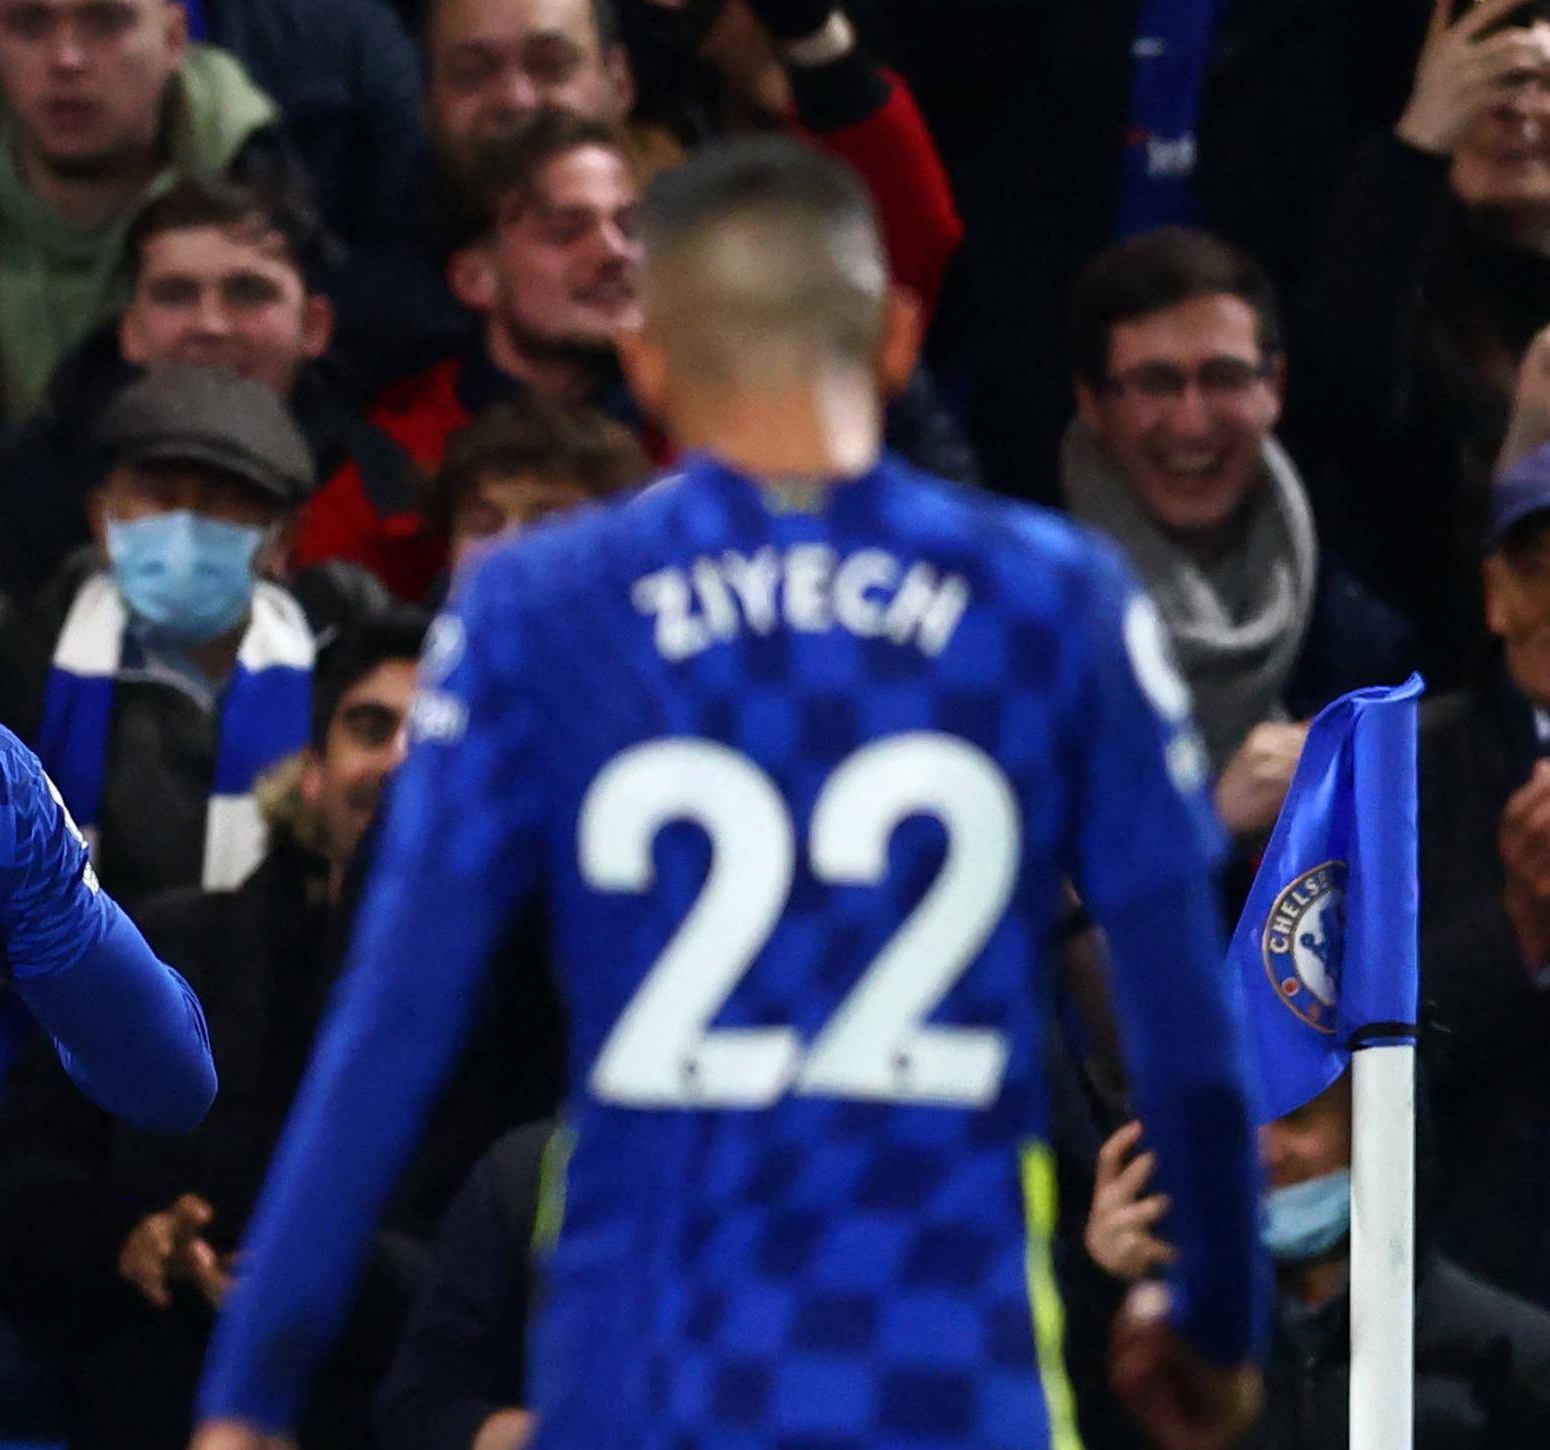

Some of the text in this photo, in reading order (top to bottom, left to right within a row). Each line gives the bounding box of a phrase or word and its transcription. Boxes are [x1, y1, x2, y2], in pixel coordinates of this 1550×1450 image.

[632, 542, 971, 662] ZIYECH
[576, 730, 1025, 1111] 22
[1270, 870, 1328, 954] CHELS
